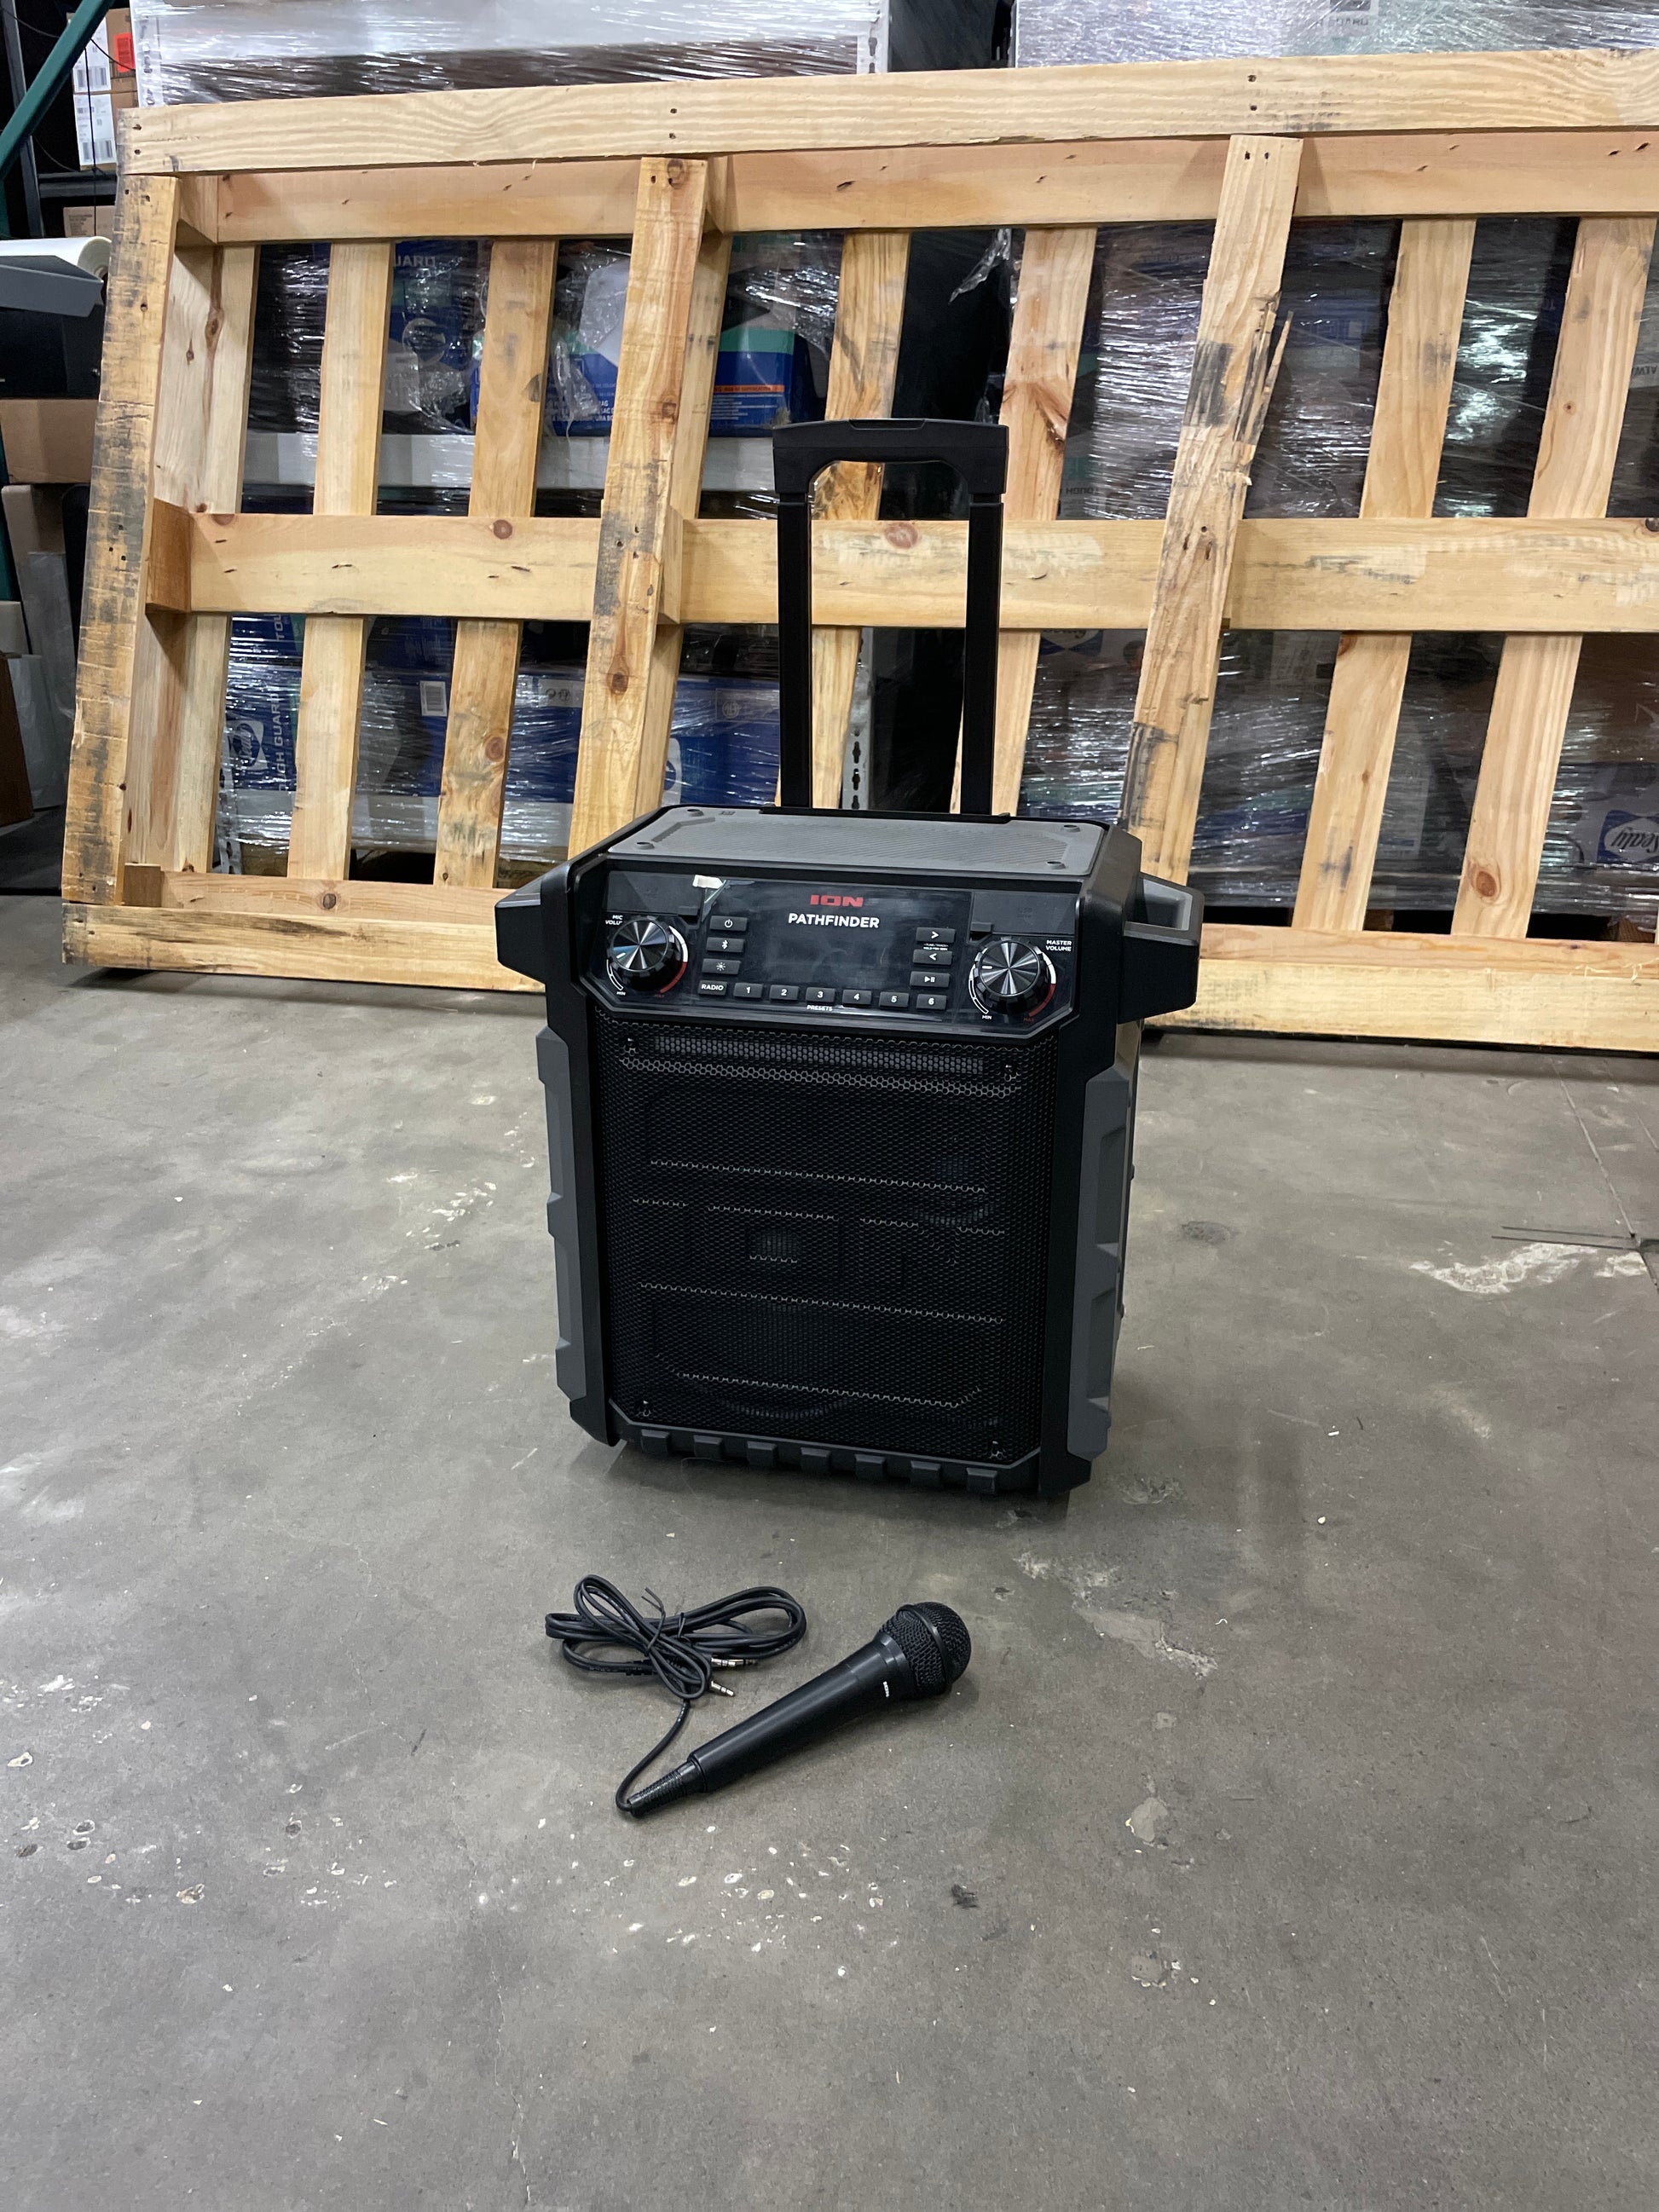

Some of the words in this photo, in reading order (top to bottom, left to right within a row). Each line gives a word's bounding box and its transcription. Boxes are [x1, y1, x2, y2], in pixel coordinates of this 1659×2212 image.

[395, 255, 436, 267] UARD
[271, 693, 284, 747] GUARD
[275, 753, 287, 791] OUGH
[810, 895, 864, 907] ION
[788, 913, 880, 928] PATHFINDER
[891, 995, 897, 1003] 5
[928, 997, 934, 1006] 6
